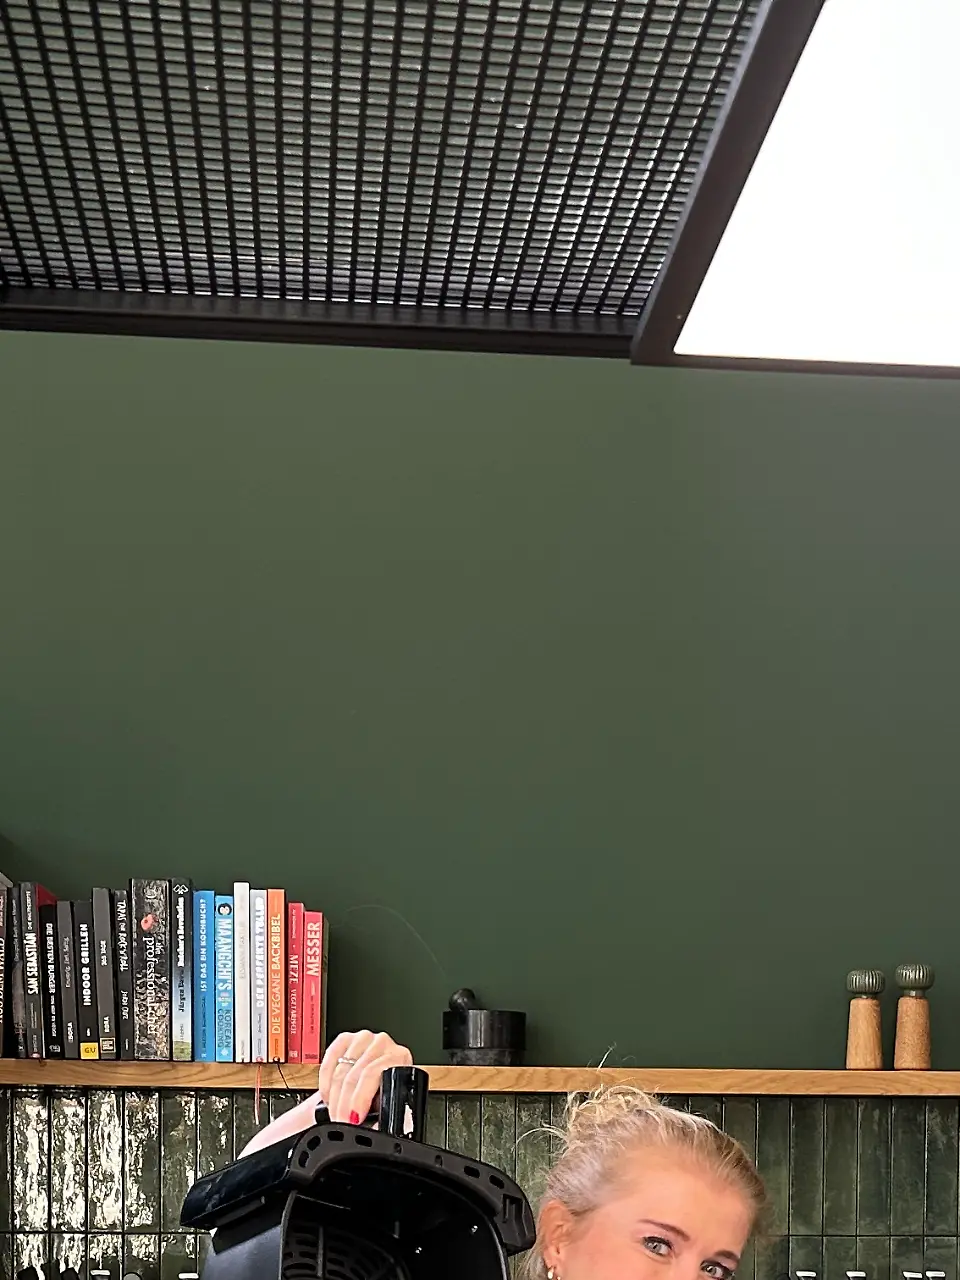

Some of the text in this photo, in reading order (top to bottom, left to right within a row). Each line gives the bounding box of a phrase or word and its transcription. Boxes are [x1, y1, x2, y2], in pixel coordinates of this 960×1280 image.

[199, 898, 207, 947] KOCHBUCH?
[271, 913, 281, 970] BACKBIBEL
[79, 923, 92, 1006] INDOOR GRILLEN
[199, 948, 207, 961] EIN
[217, 918, 232, 991] MAANGCHI'S
[288, 954, 299, 984] MEZE
[306, 922, 320, 977] MESSER
[27, 978, 39, 995] SAN
[142, 936, 160, 1035] professional chef
[271, 972, 281, 1015] VEGANE
[217, 1008, 225, 1048] COOKING
[224, 1008, 232, 1048] KOREAN
[271, 1017, 281, 1034] DIE
[84, 1046, 96, 1054] GU
